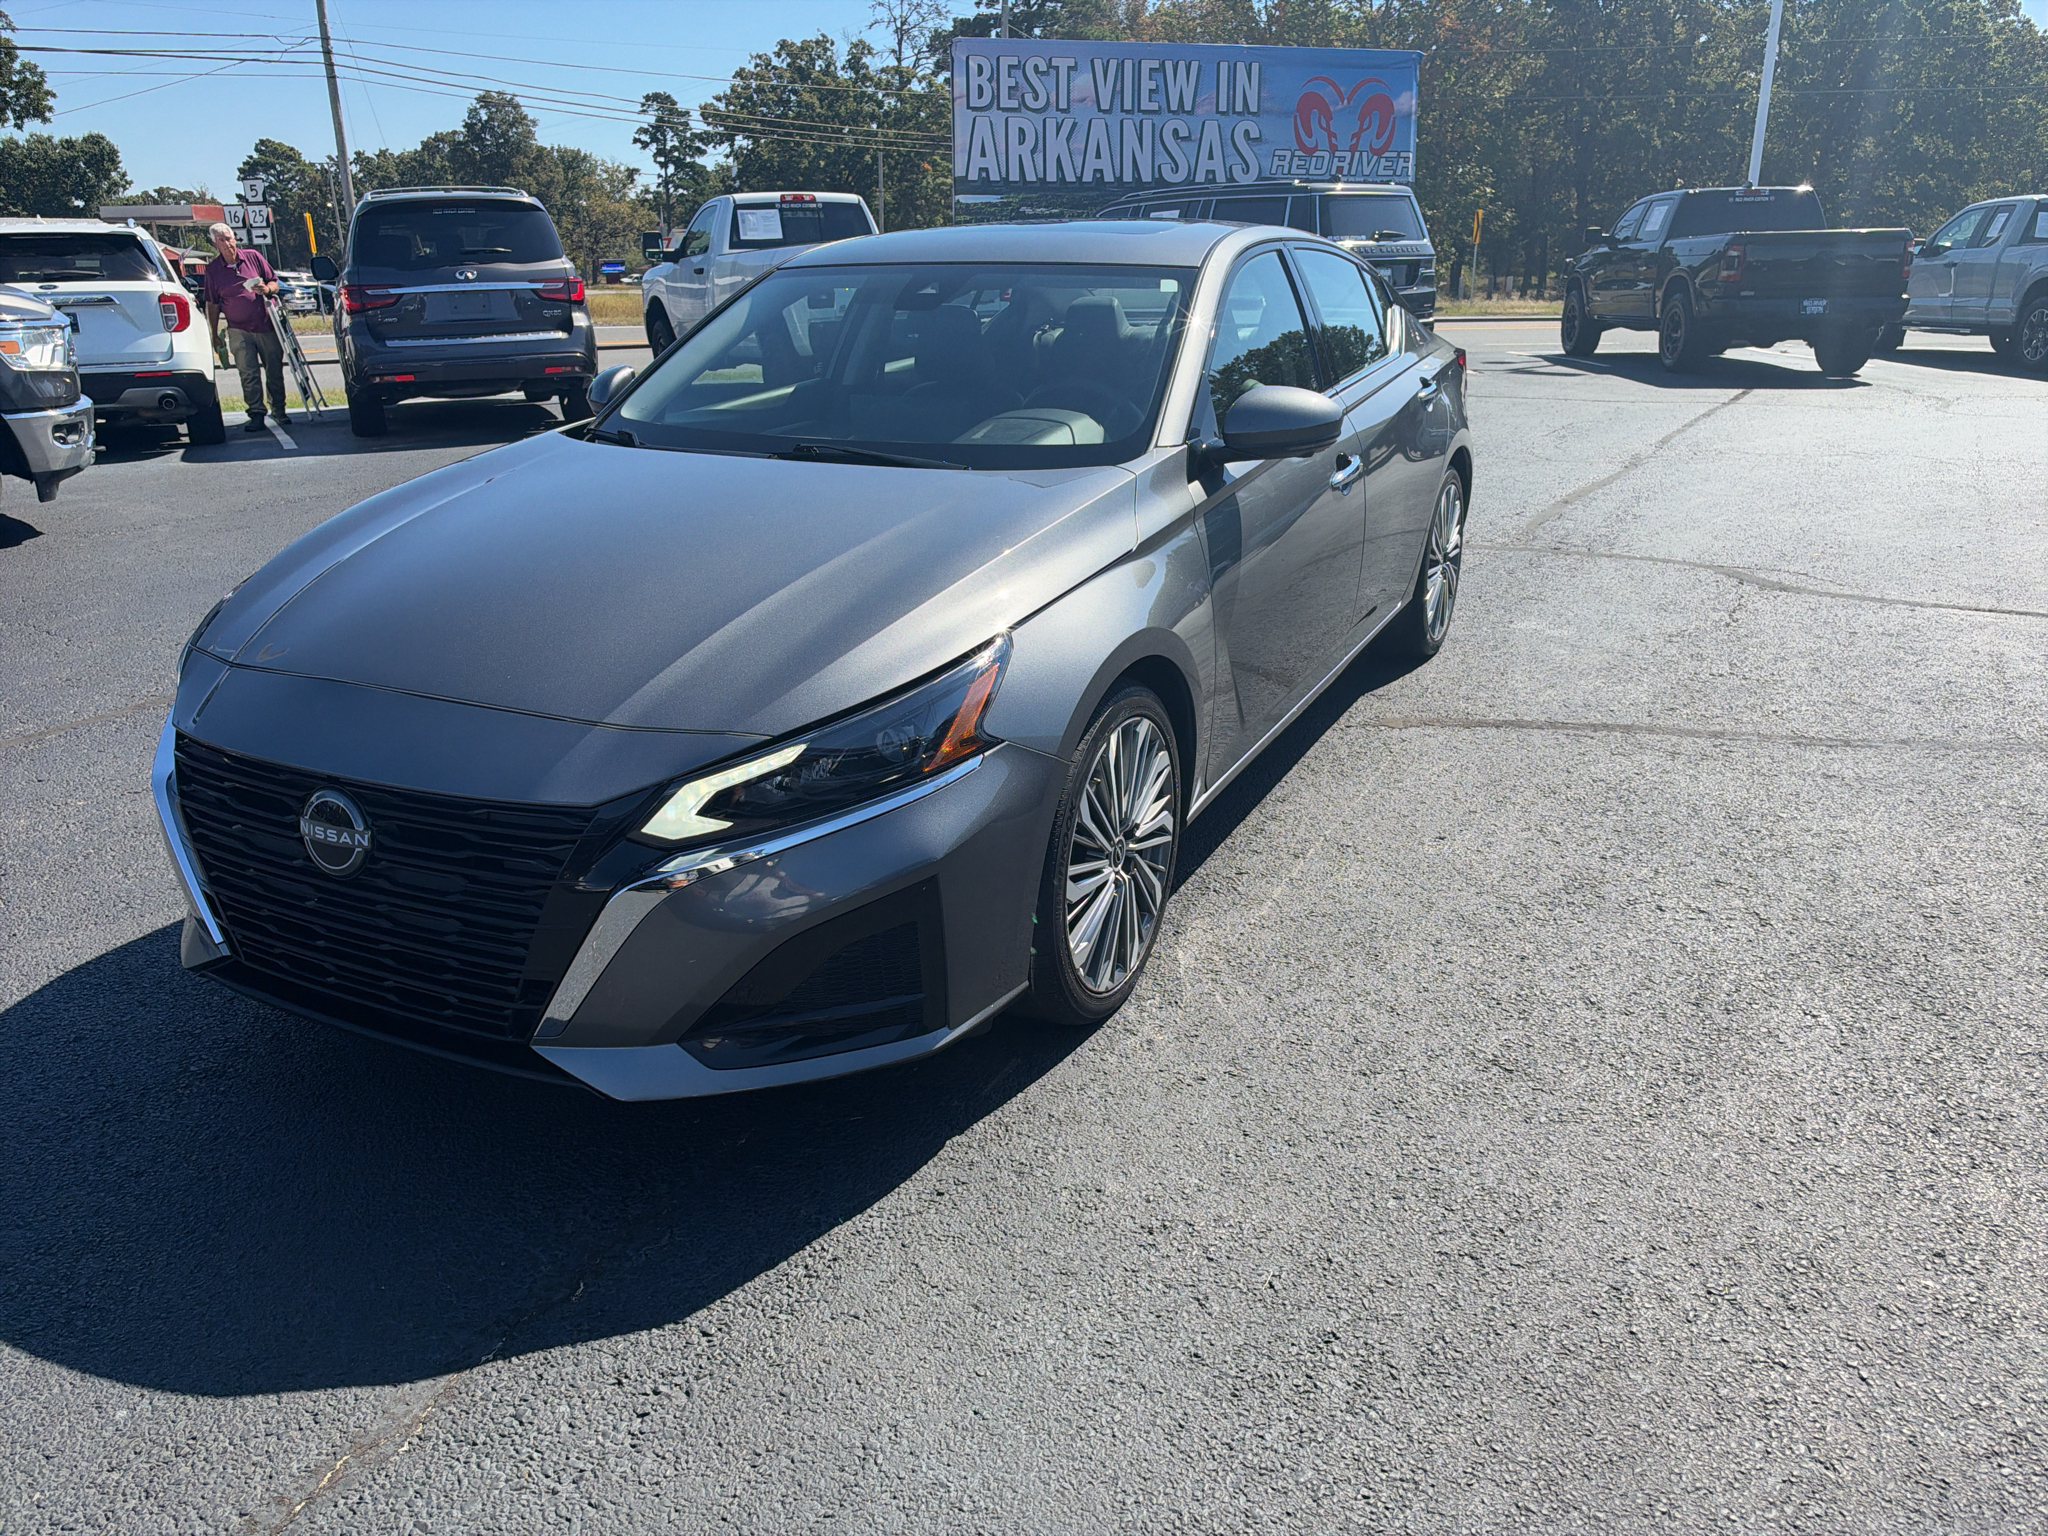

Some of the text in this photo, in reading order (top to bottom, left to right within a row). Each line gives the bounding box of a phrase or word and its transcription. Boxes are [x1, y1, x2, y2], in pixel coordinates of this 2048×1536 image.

[967, 55, 1261, 114] BEST VIEW IN
[967, 115, 1262, 184] ARKANSAS
[250, 184, 259, 198] 5
[228, 210, 240, 224] 16
[251, 209, 264, 223] 25
[300, 820, 369, 847] NISSAN
